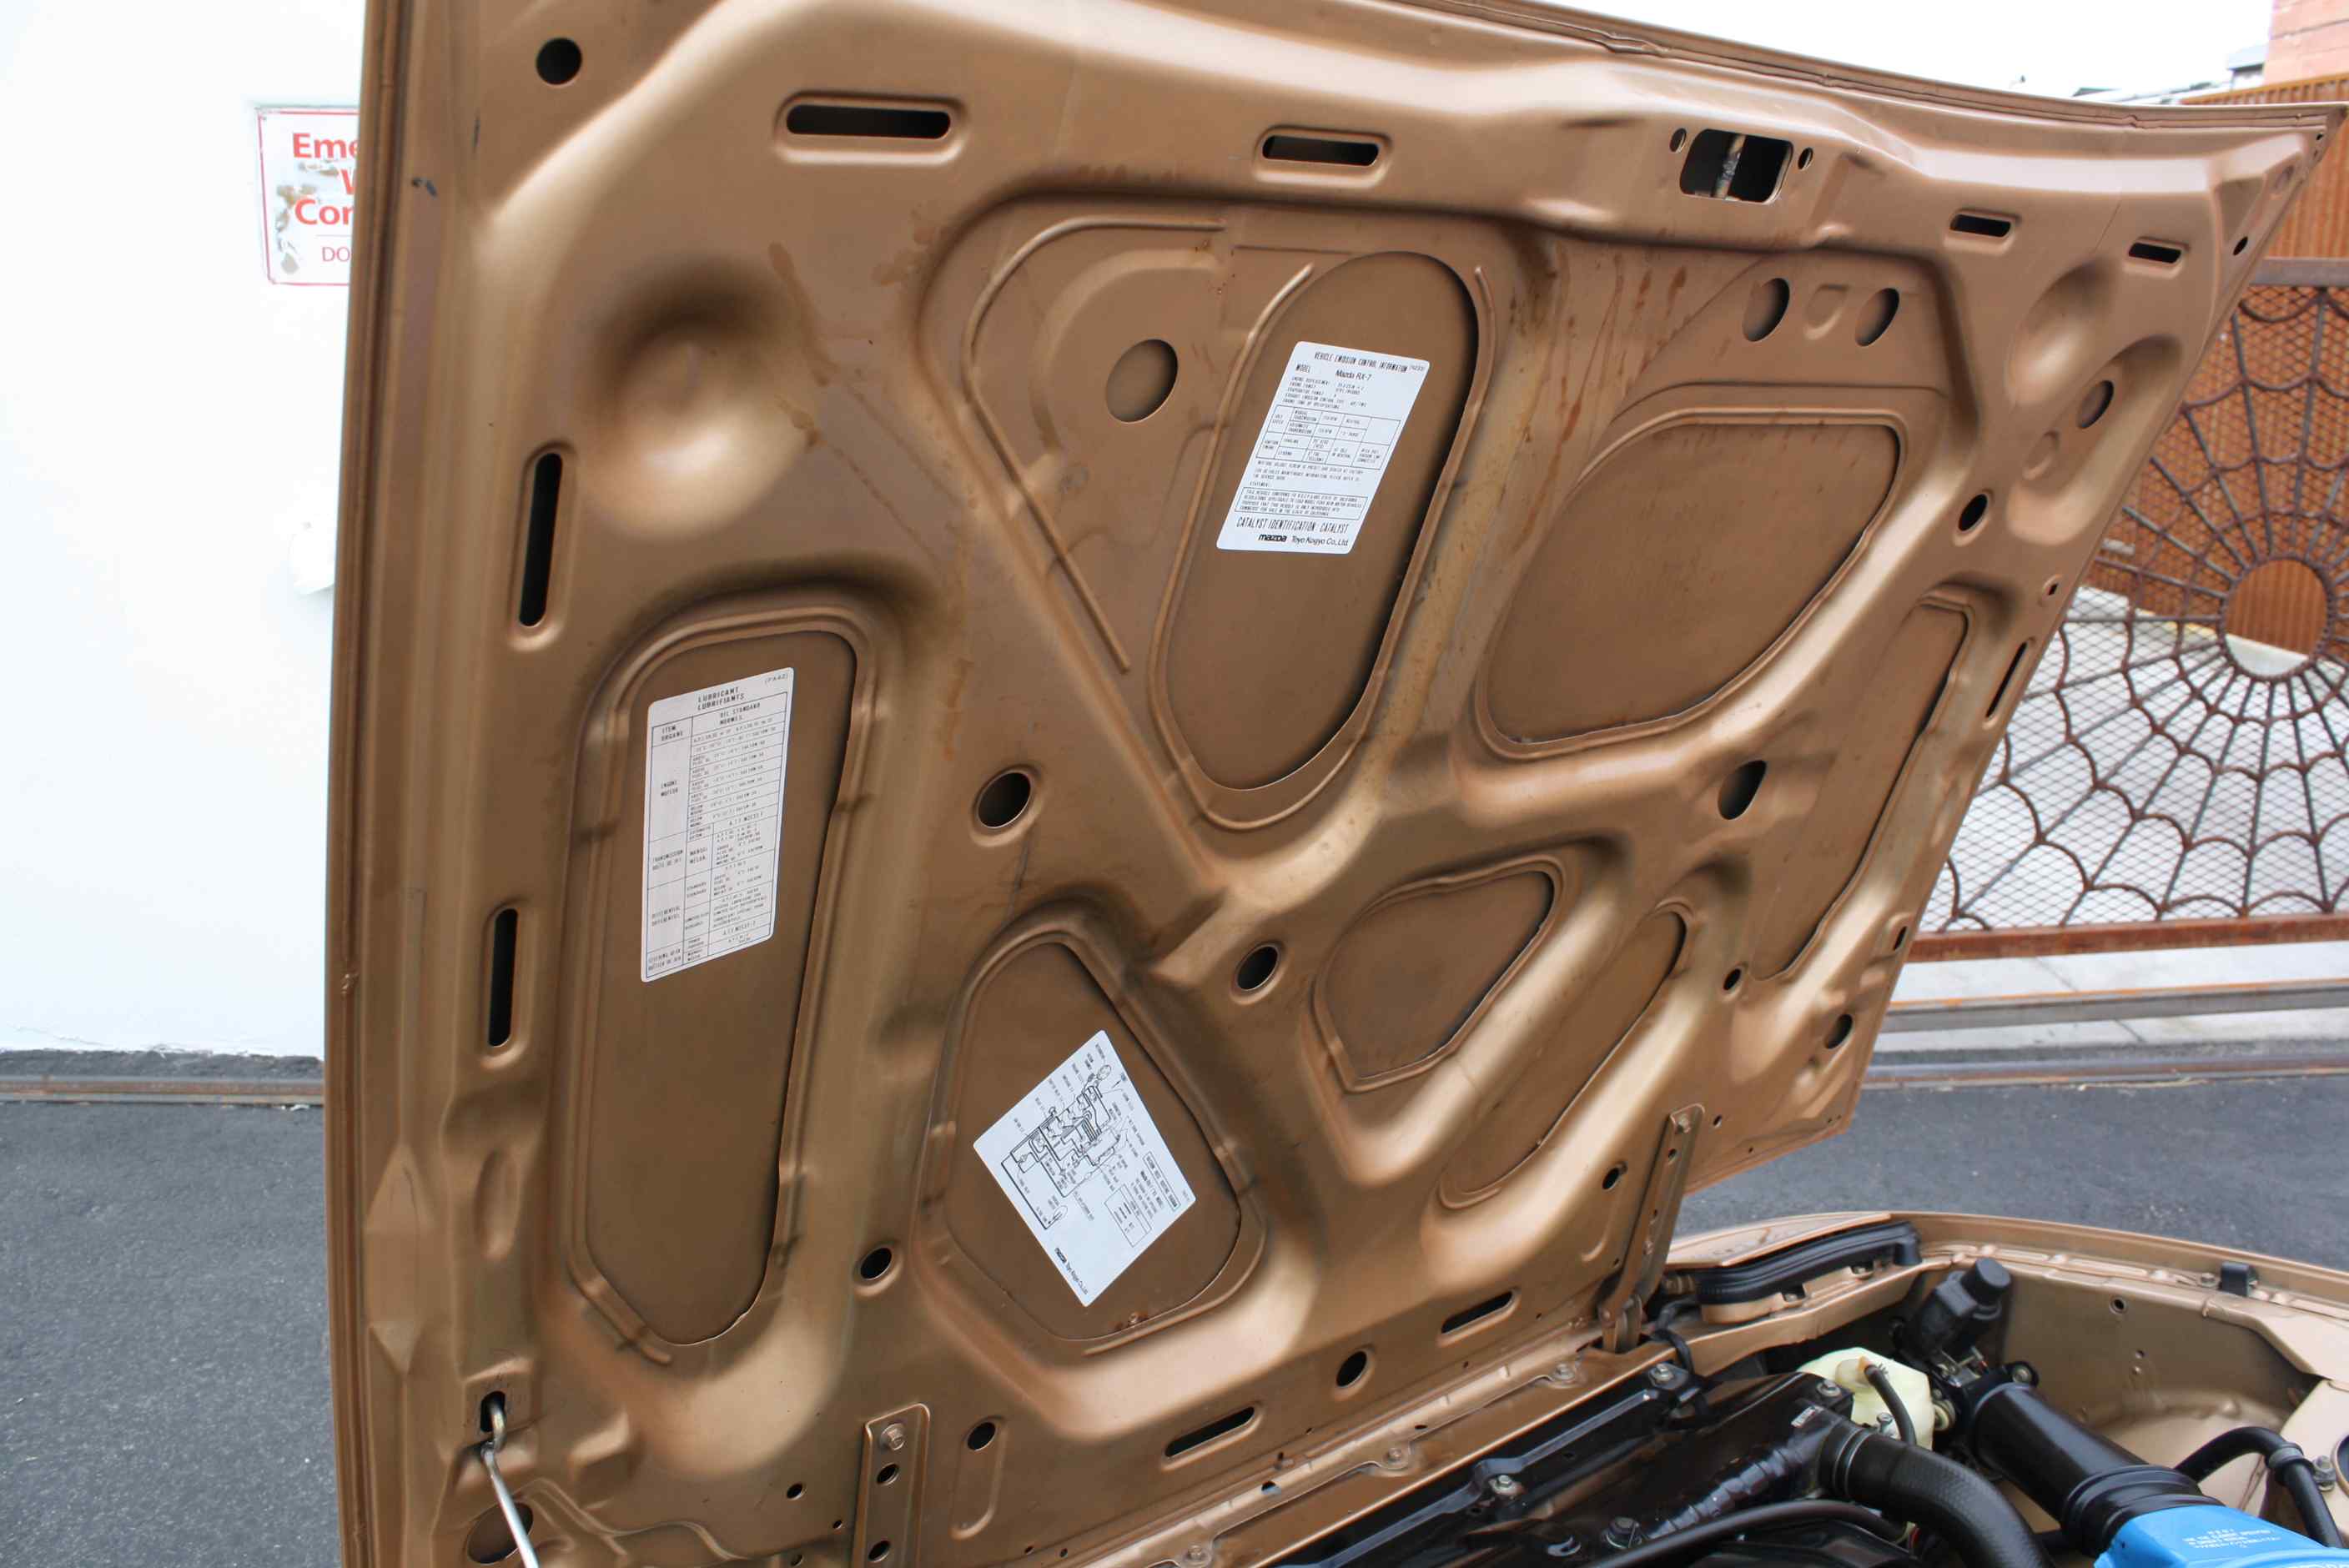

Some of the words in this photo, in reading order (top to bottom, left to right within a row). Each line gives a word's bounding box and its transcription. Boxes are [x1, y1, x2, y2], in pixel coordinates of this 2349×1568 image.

[1356, 371, 1372, 381] RX-7
[1236, 516, 1267, 529] CATALYST
[1320, 523, 1350, 534] CATALYST
[1258, 533, 1288, 542] mazda
